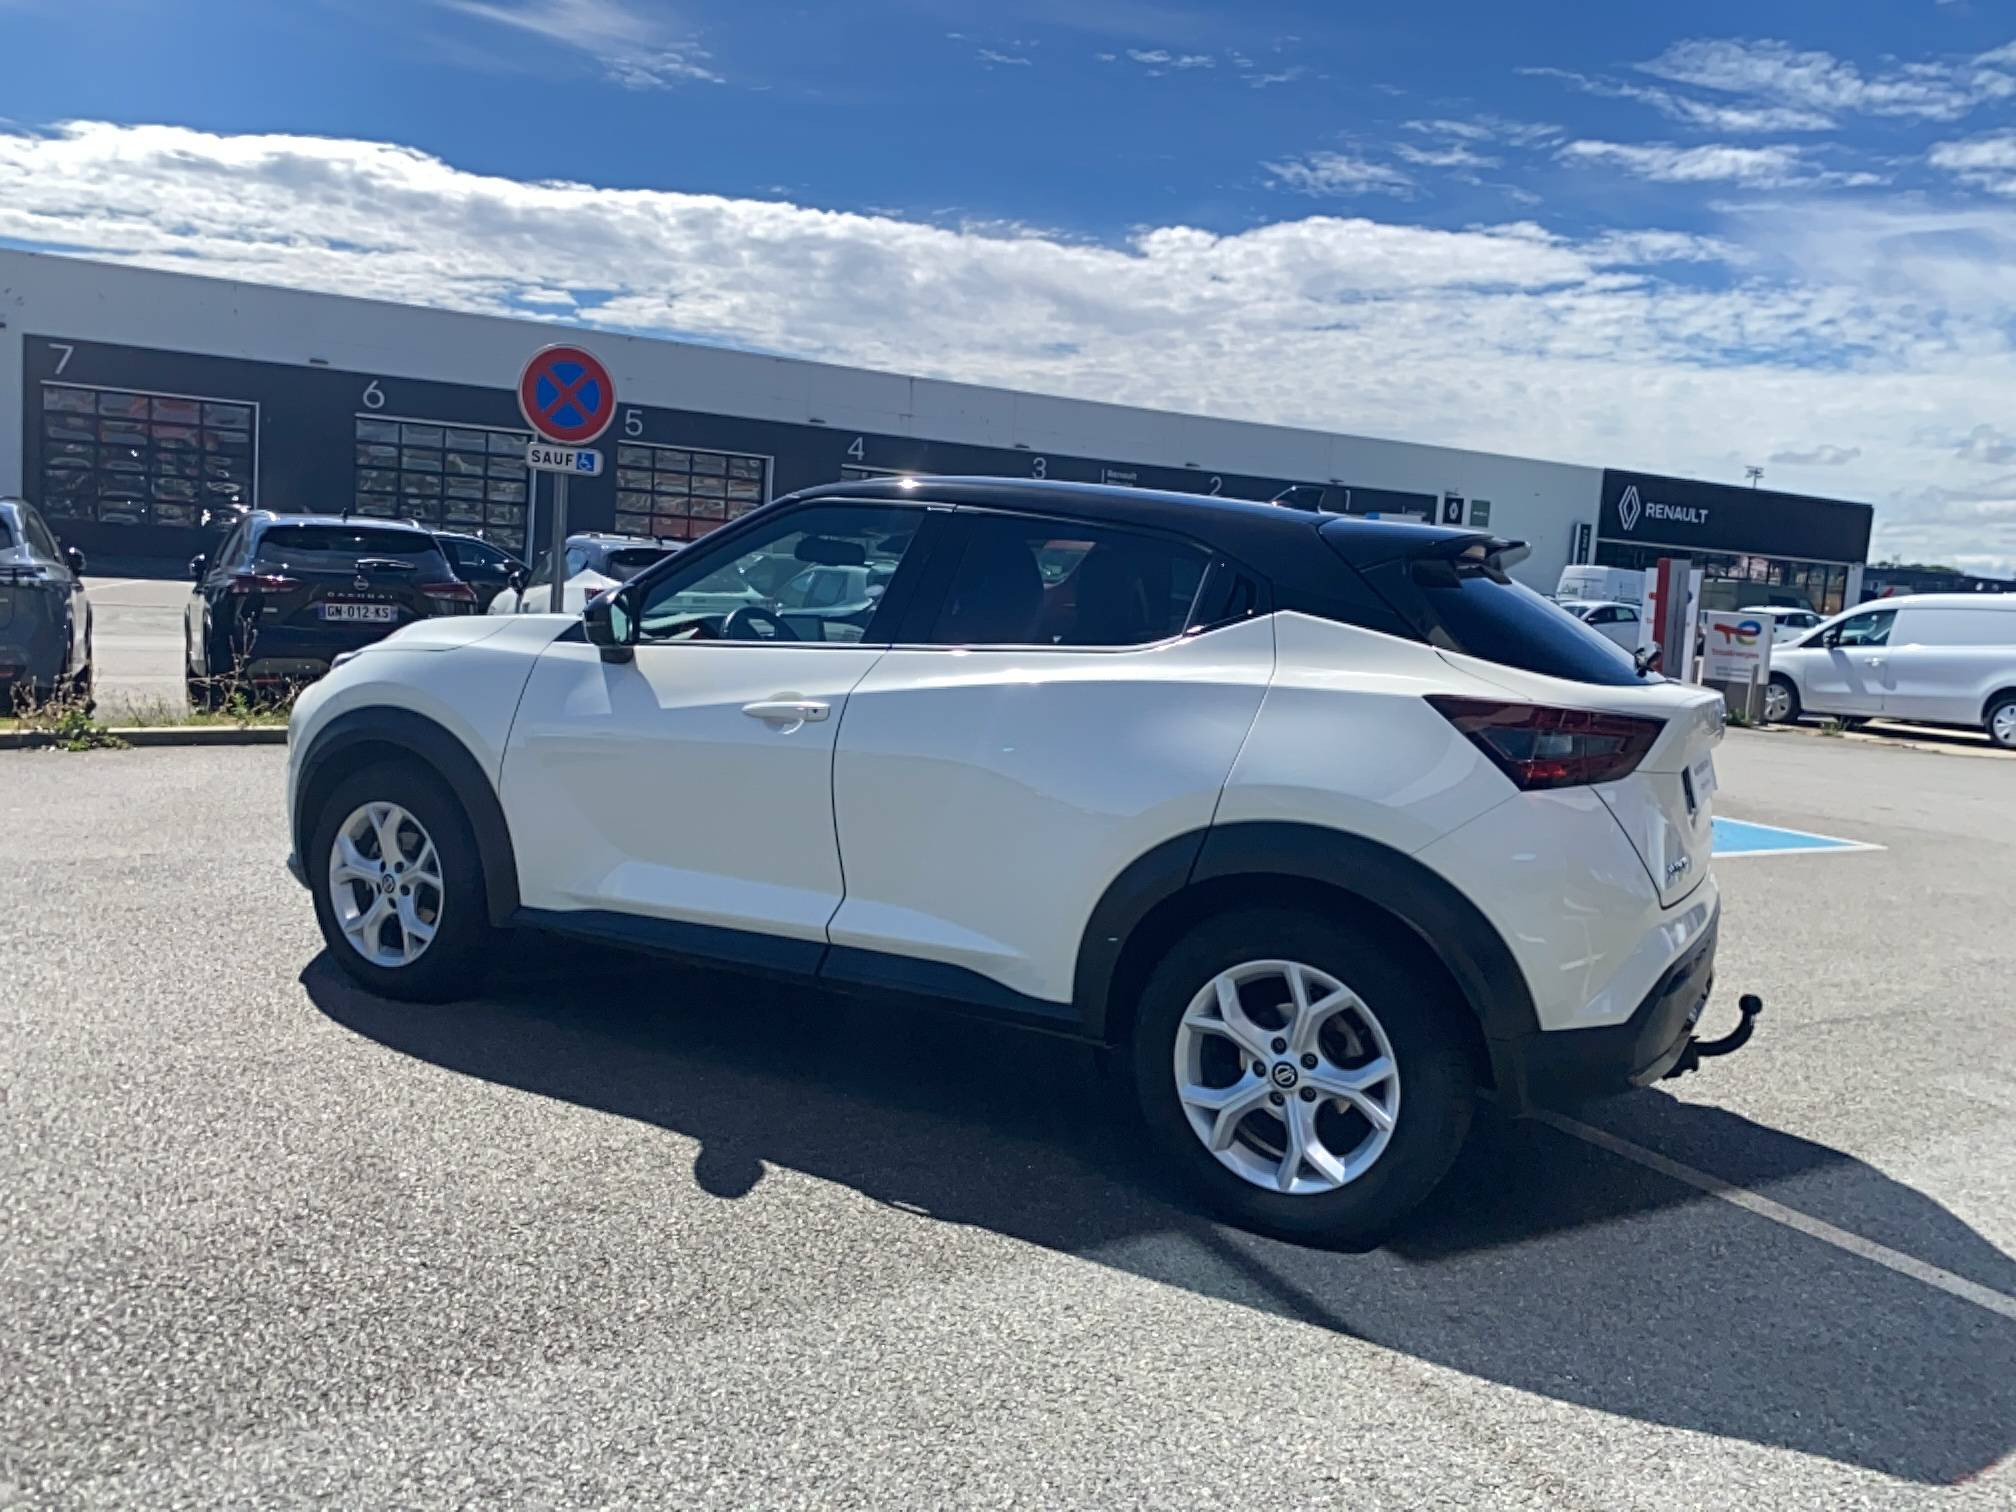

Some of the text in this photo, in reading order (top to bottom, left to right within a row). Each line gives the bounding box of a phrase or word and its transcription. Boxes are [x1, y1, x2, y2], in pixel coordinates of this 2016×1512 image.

[48, 343, 74, 375] 7
[363, 380, 385, 409] 6
[625, 409, 643, 436] 5
[531, 449, 574, 466] SAUF
[847, 436, 864, 461] 4
[1032, 457, 1047, 480] 3
[1209, 476, 1223, 496] 2
[1645, 502, 1709, 524] RENAULT
